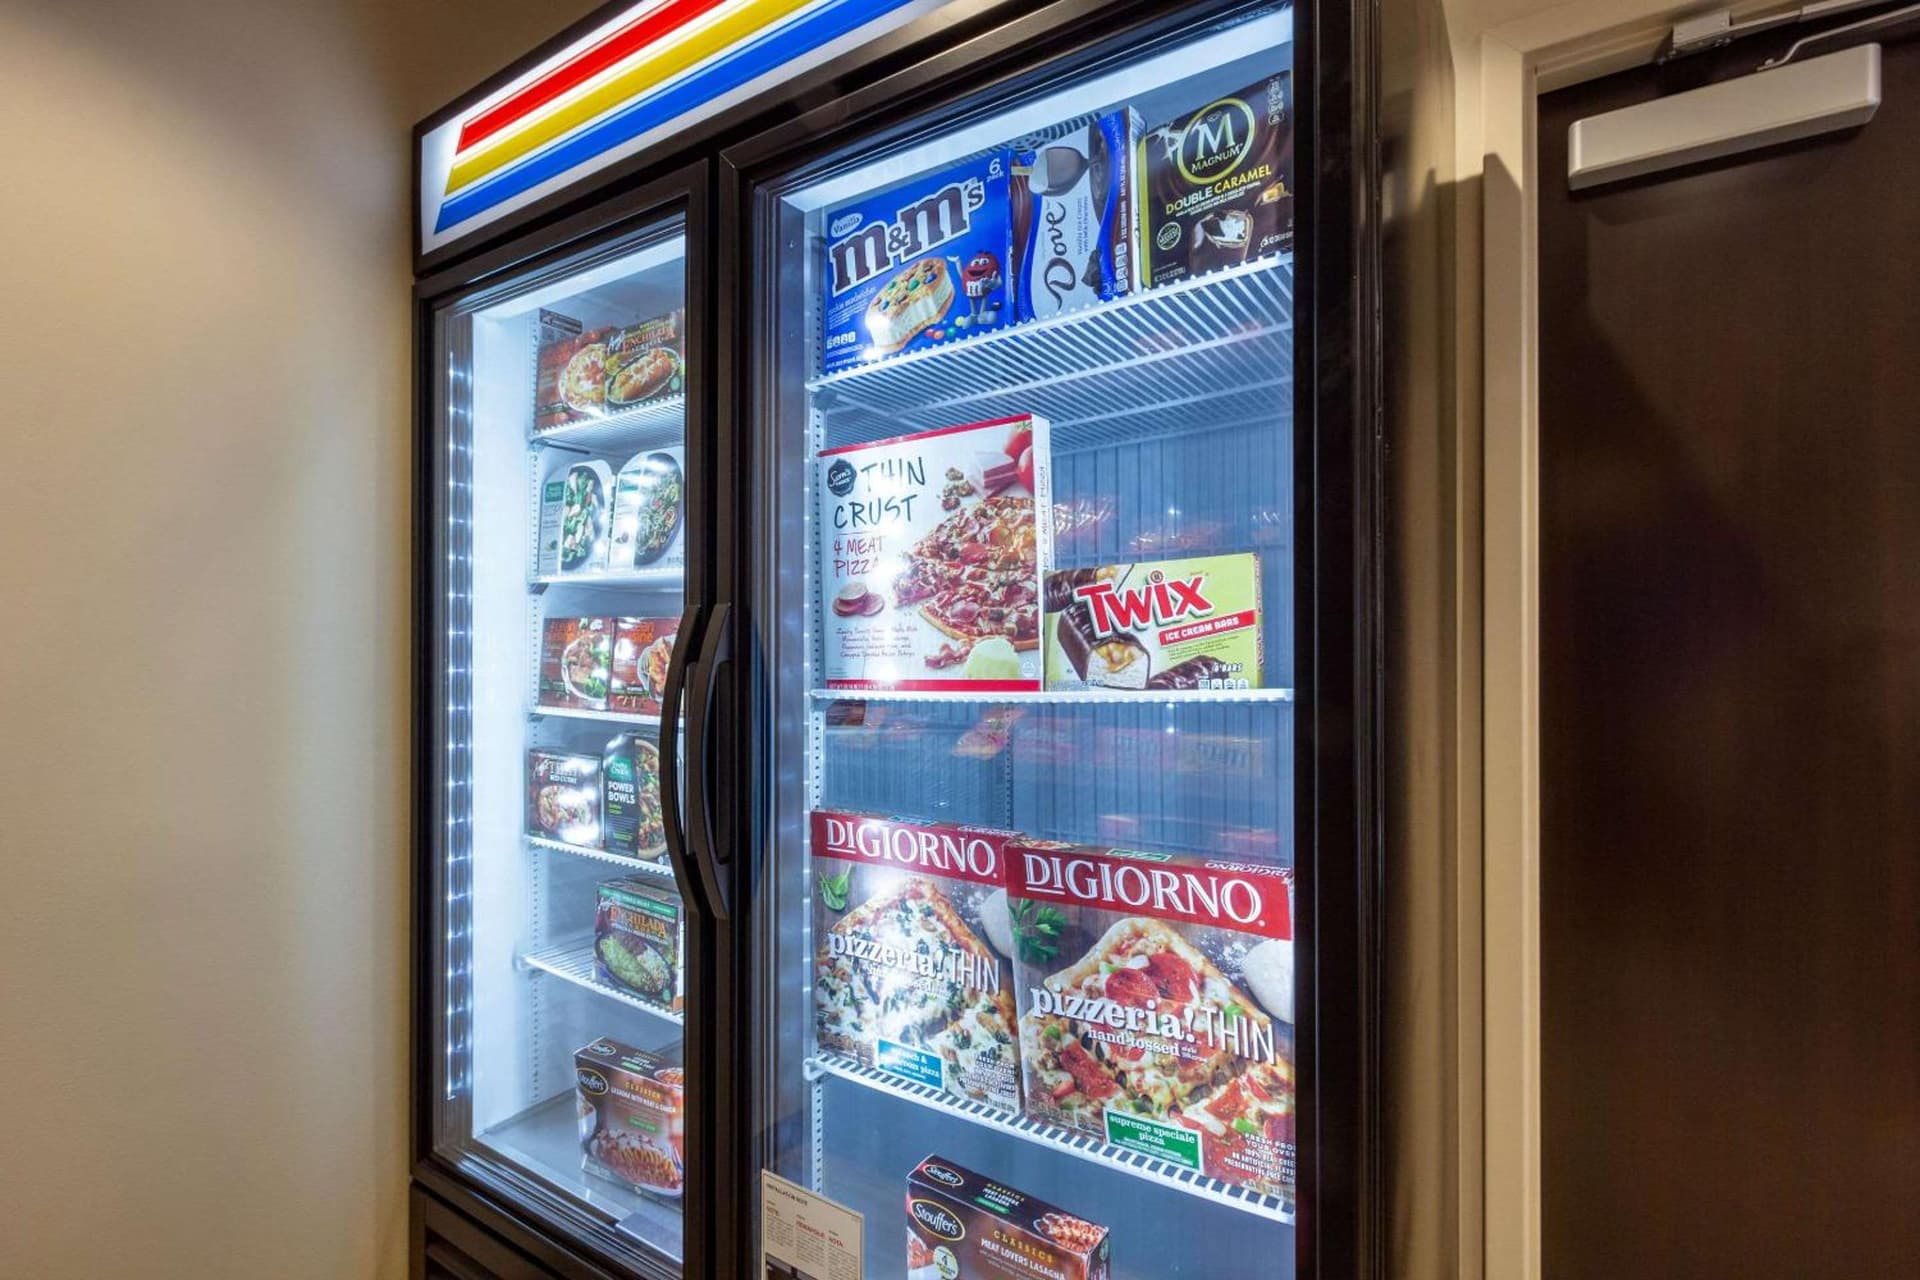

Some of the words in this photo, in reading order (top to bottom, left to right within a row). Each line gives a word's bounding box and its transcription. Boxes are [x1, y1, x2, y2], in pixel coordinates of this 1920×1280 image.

[989, 158, 1001, 174] 6
[1191, 144, 1240, 173] MAGNUM
[1166, 186, 1213, 216] DOUBLE
[1214, 164, 1272, 194] CARAMEL
[833, 215, 861, 236] Vanilla
[1044, 202, 1077, 310] Dove
[860, 457, 925, 492] THIN
[833, 494, 918, 529] CRUST
[833, 538, 842, 555] 4
[846, 535, 884, 556] MEAT
[1165, 630, 1181, 641] ICE
[1181, 623, 1213, 638] CREAM
[1214, 616, 1240, 630] BARS
[607, 781, 634, 794] POWER
[607, 792, 635, 805] BOWLS
[949, 948, 1001, 996] THIN
[1030, 979, 1197, 1043] pizzeria!
[1198, 1005, 1277, 1065] THIN
[1109, 1115, 1152, 1133] supreme
[1153, 1126, 1195, 1144] speciale
[1138, 1131, 1165, 1147] pizza
[1245, 1133, 1273, 1145] FRESH
[1274, 1141, 1296, 1152] FRO
[927, 1166, 959, 1184] Stouffer's
[914, 1203, 959, 1236] Stouffer's
[981, 1238, 1000, 1251] MEAT
[1000, 1246, 1030, 1267] LOVERS
[1029, 1258, 1066, 1280] LASAGNA
[993, 1230, 1055, 1264] CLASSICS
